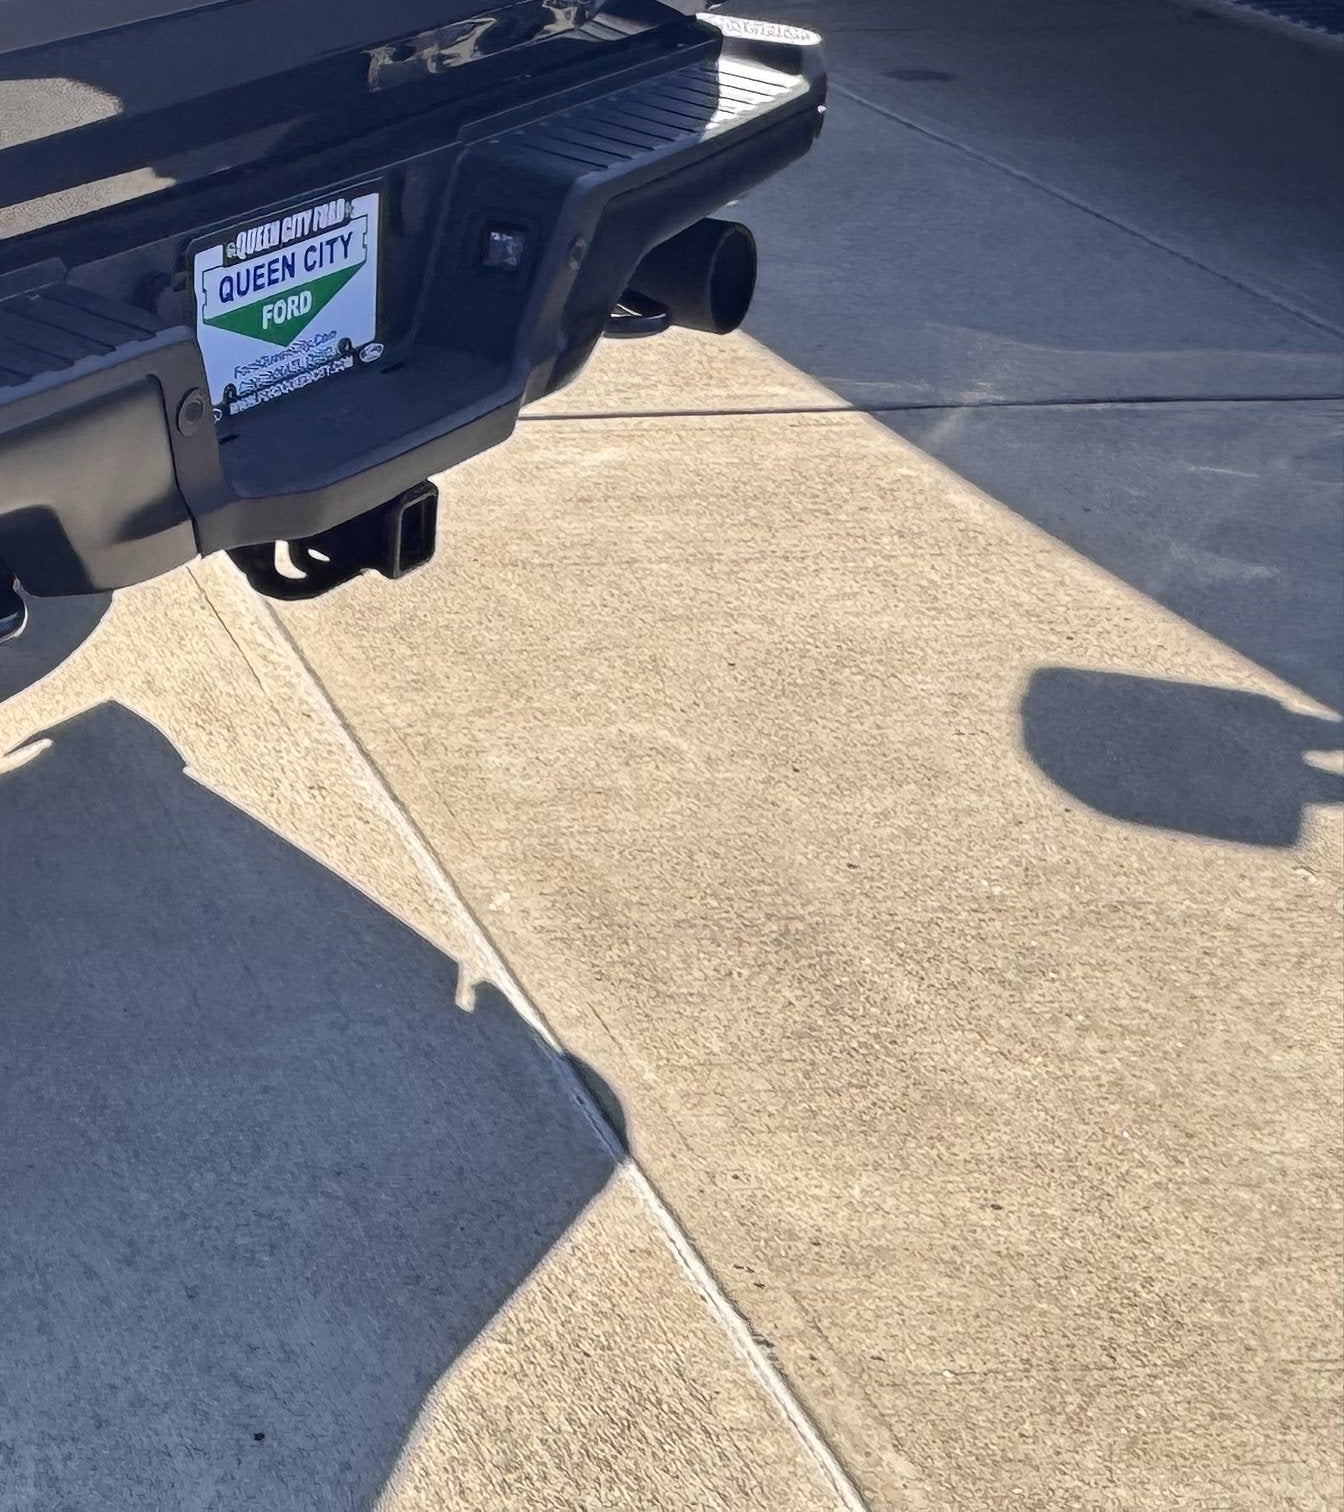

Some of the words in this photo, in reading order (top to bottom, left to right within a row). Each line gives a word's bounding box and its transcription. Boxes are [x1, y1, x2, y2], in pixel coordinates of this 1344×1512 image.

[219, 252, 296, 303] QUEEN
[304, 231, 354, 272] CITY
[262, 291, 311, 329] FORD
